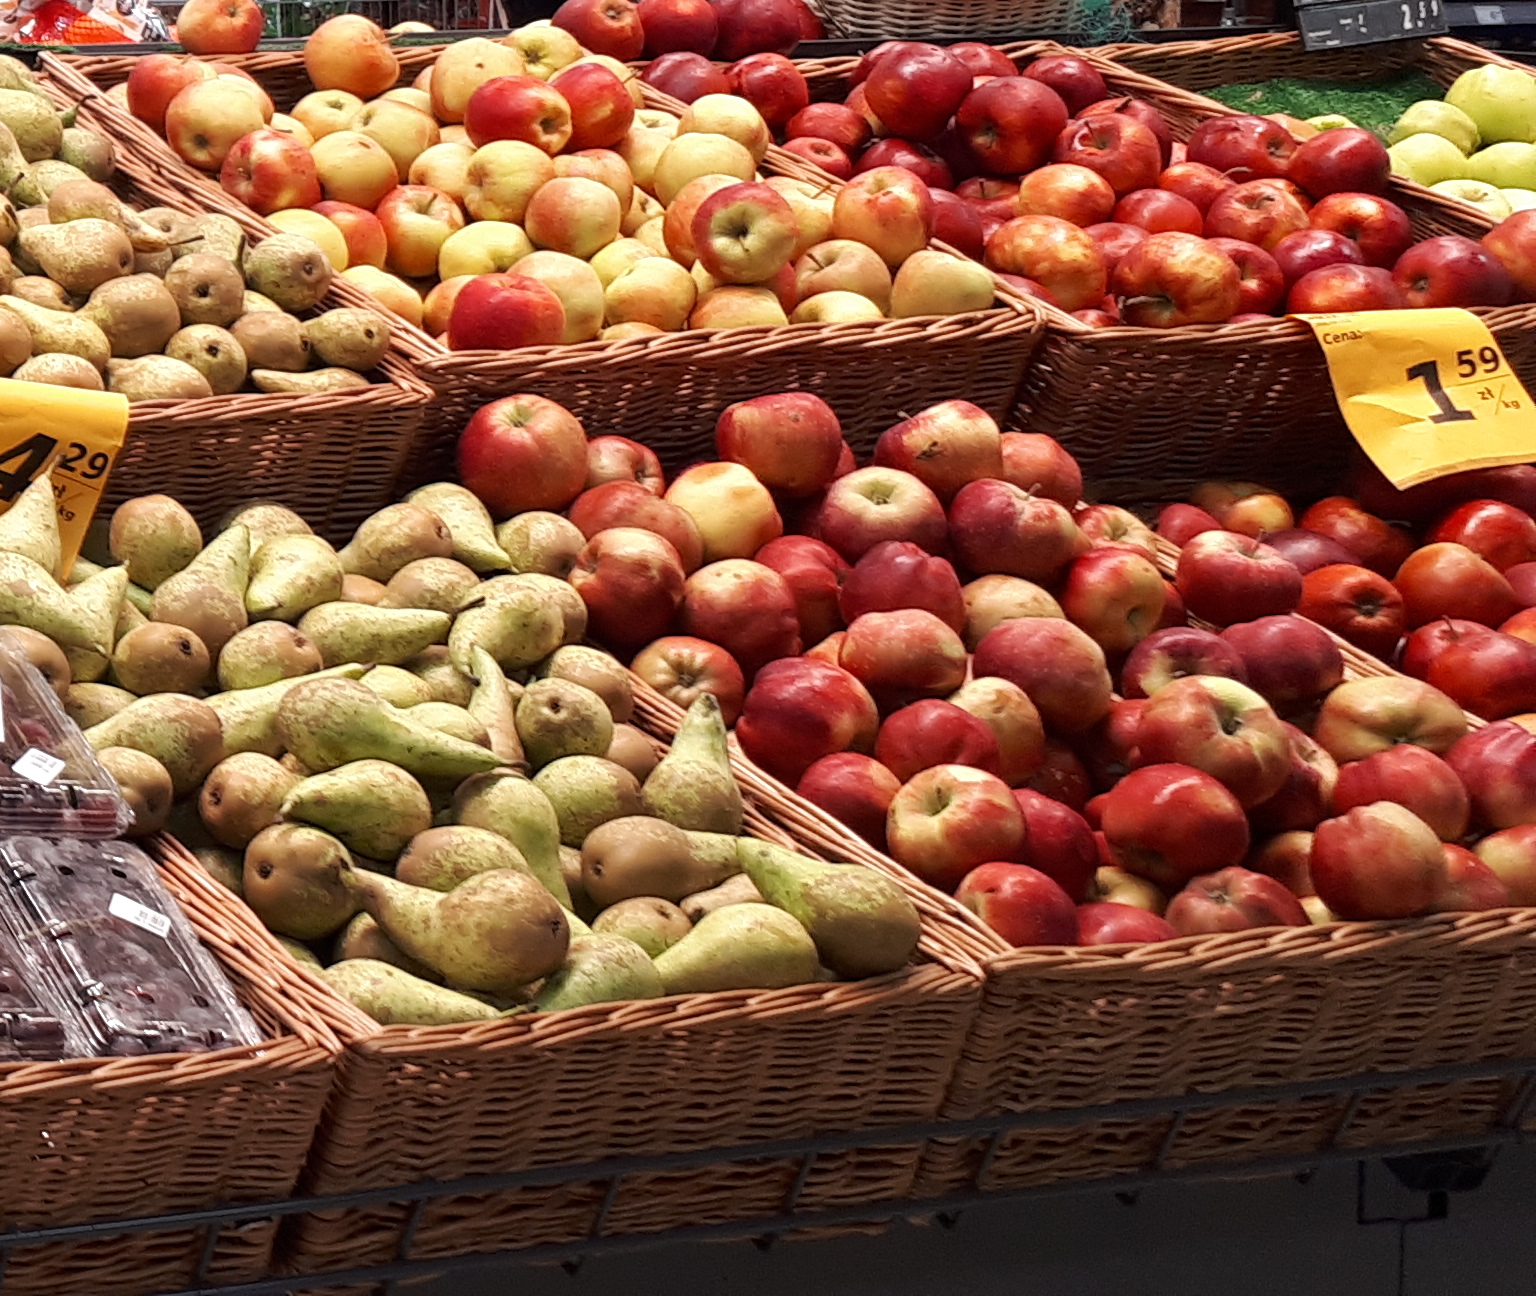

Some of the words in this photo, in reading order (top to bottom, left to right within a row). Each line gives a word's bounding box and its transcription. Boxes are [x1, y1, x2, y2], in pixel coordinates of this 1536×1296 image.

[1323, 330, 1363, 345] Cena:
[1406, 360, 1478, 424] 1
[1456, 346, 1500, 378] 59
[61, 442, 109, 479] 29
